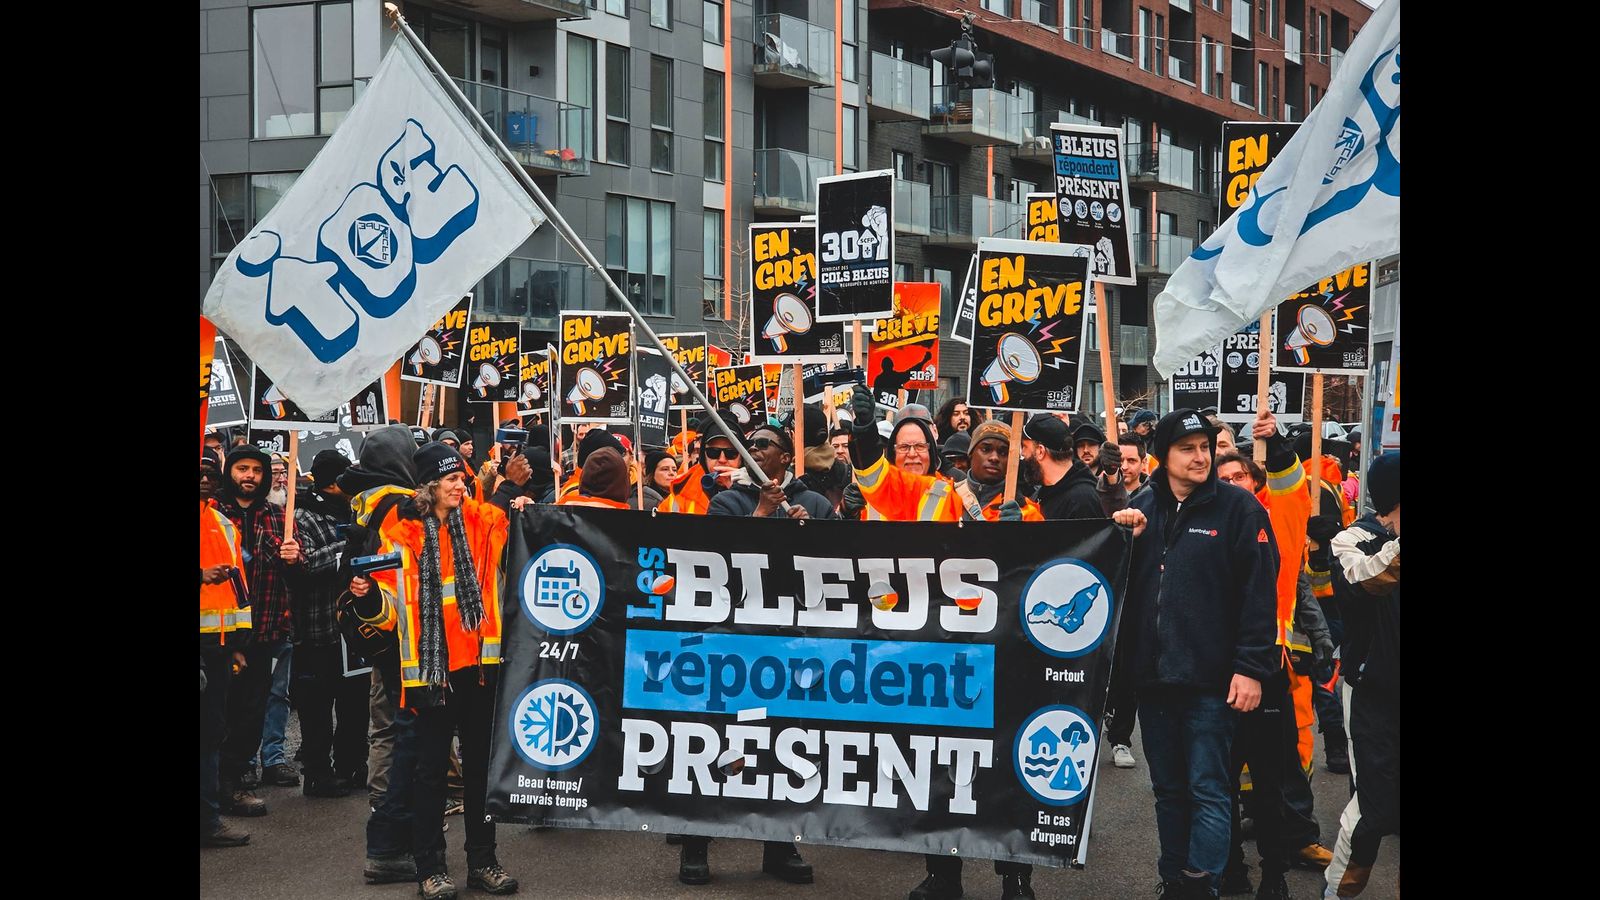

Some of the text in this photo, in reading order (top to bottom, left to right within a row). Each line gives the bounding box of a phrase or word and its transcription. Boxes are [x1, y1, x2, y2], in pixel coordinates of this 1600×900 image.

[1060, 135, 1118, 159] BLEUS
[1228, 133, 1268, 173] EN
[1059, 157, 1116, 176] répondent
[1056, 173, 1120, 200] PRÉSENT
[1029, 198, 1057, 225] EN
[755, 229, 789, 262] EN
[821, 267, 889, 284] COLS BLEUS
[981, 255, 1025, 293] EN
[979, 278, 1083, 328] GRÈVE
[470, 326, 490, 345] EN
[564, 317, 591, 342] EN
[469, 337, 517, 361] GRÈVE
[563, 331, 630, 365] GRÈVE
[717, 369, 735, 388] EN
[718, 376, 762, 402] GRÈVE
[1174, 381, 1219, 390] COLS BLEU
[207, 394, 236, 405] LEUS
[640, 415, 665, 426] LEUS
[438, 456, 458, 467] LIBRE
[665, 548, 999, 633] BLEUS
[539, 641, 580, 661] 24/7
[643, 634, 983, 712] répondent
[1045, 667, 1085, 683] Partout
[618, 707, 994, 815] PRÉSENT
[518, 775, 582, 794] Beau temps/
[509, 793, 588, 809] mauvais temps
[1038, 811, 1071, 827] En cas
